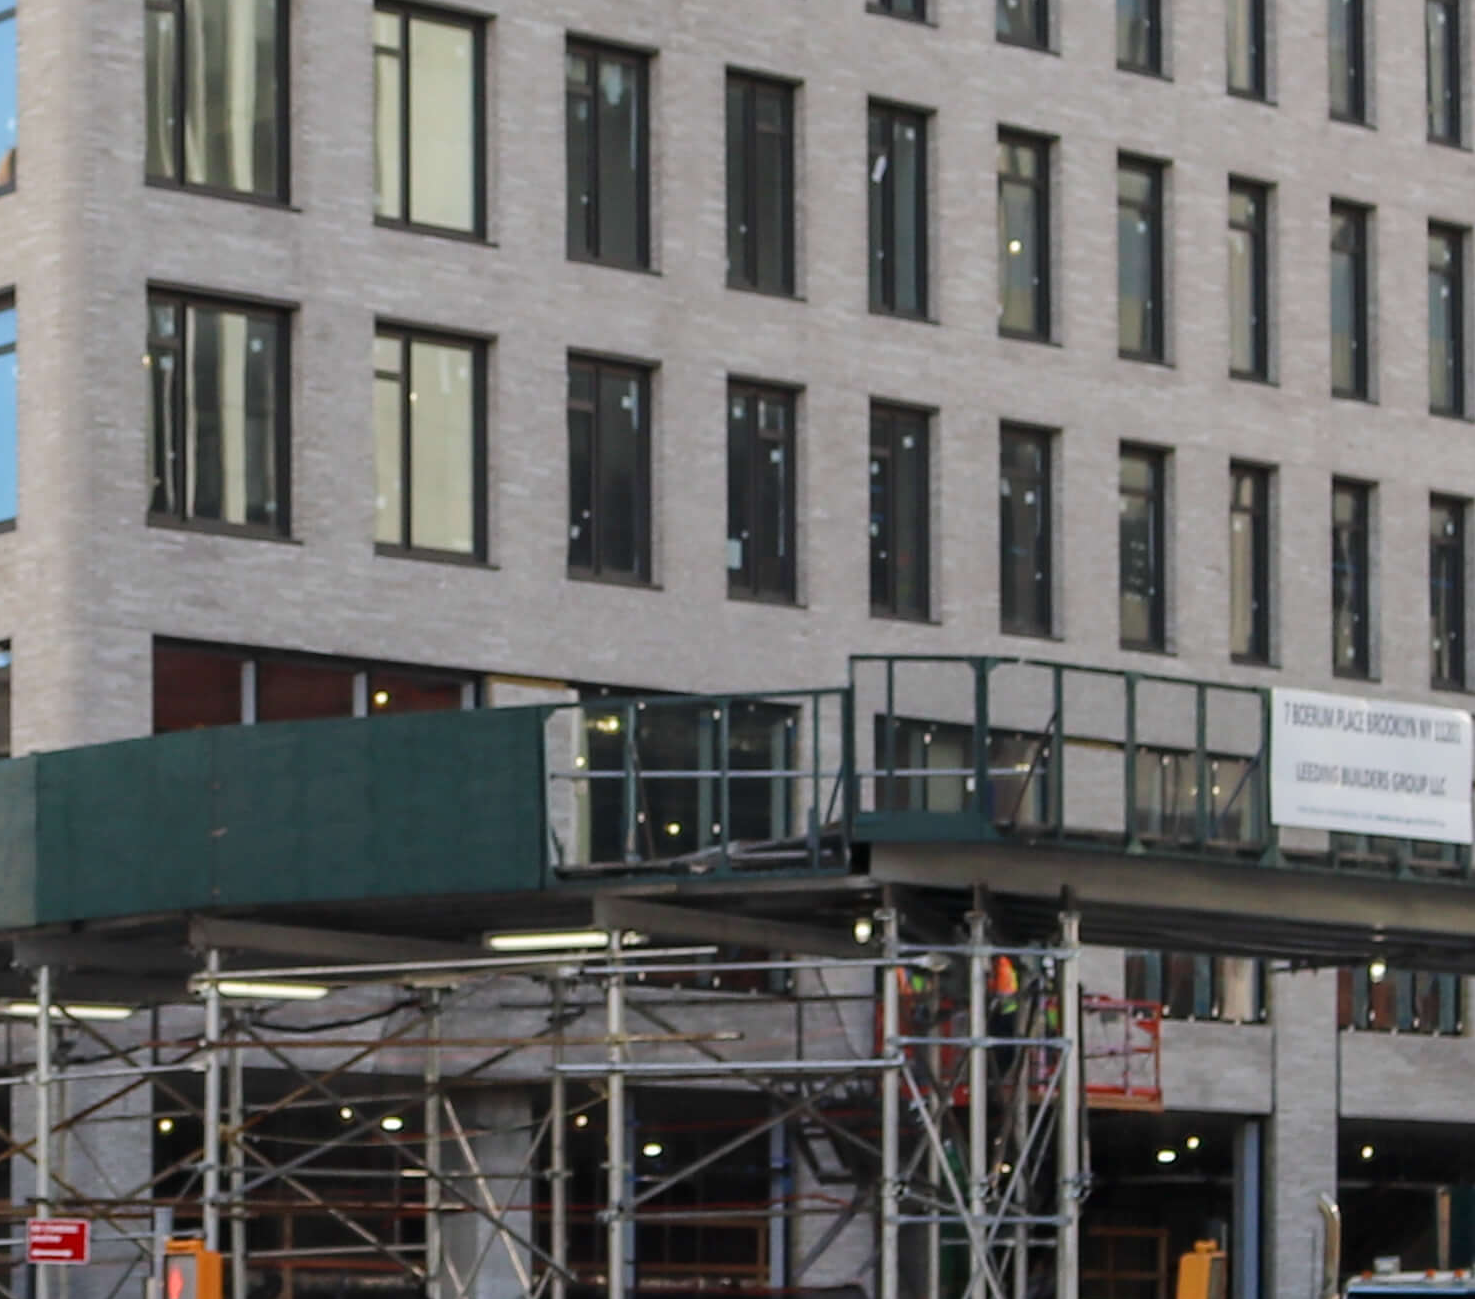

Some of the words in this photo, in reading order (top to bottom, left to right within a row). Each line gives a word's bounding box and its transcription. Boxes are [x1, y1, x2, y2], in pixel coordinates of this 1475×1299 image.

[1337, 708, 1365, 733] PLACE
[1367, 711, 1416, 739] BROOKLYN
[1341, 766, 1389, 791] BUILDERS
[1392, 772, 1428, 794] GROUP
